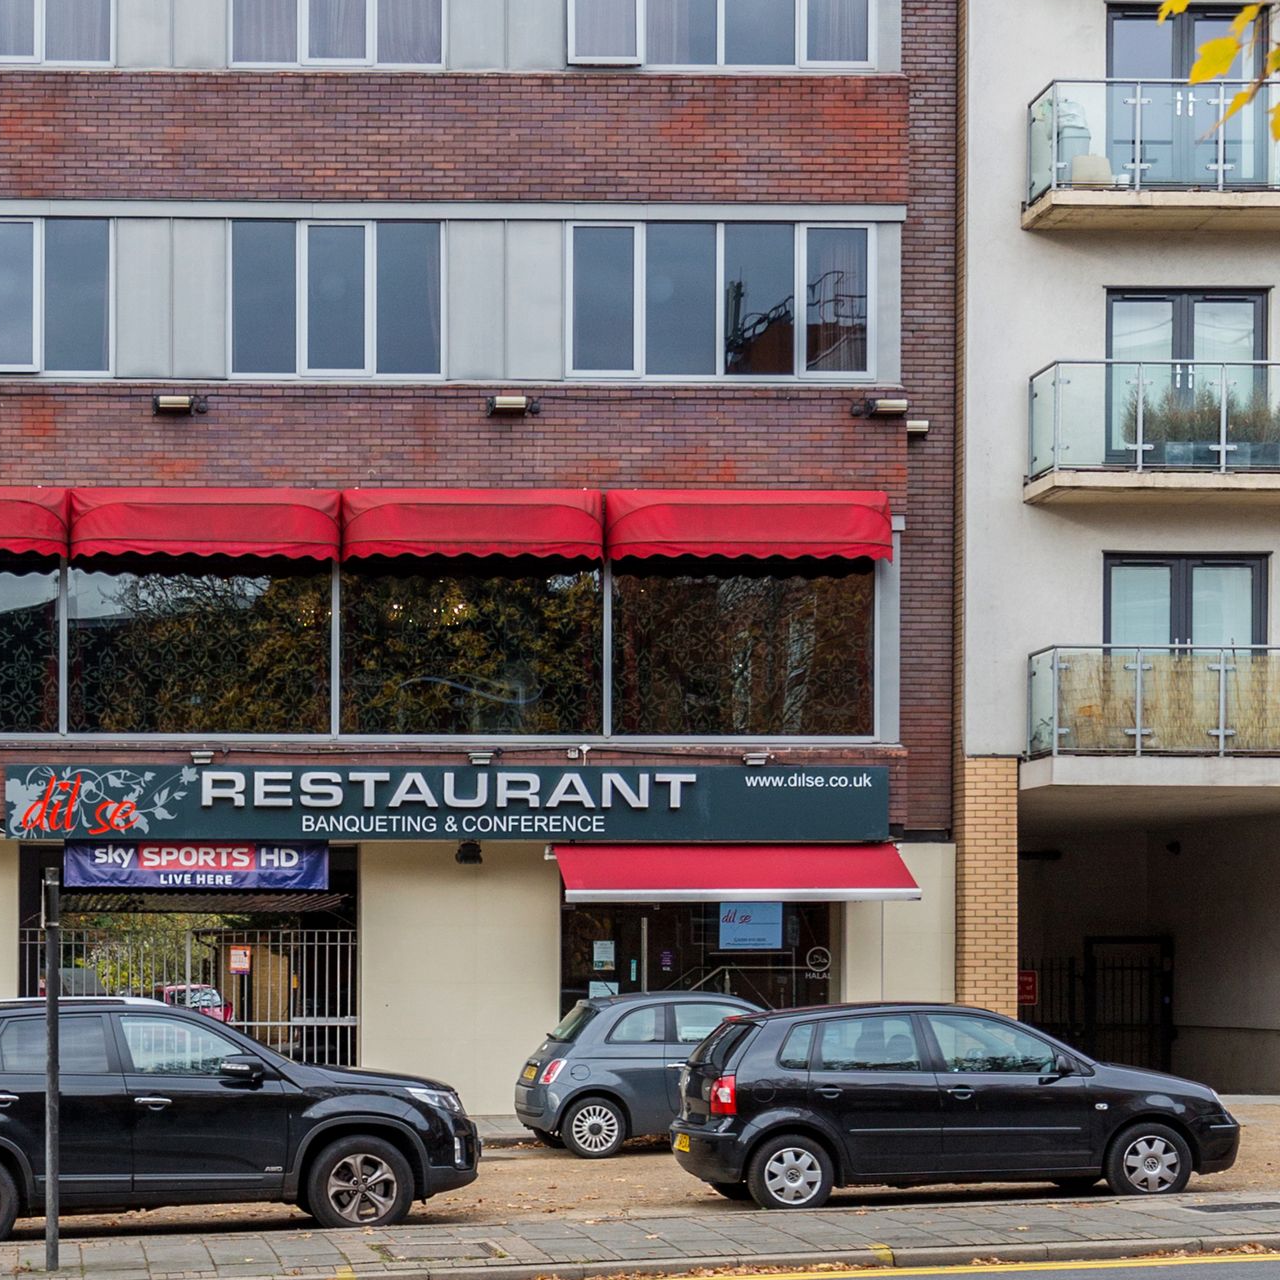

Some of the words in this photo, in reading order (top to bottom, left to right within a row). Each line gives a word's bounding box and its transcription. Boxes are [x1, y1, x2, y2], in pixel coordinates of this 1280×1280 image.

[200, 770, 697, 809] RESTAURANT
[301, 815, 437, 833] BANQUETING
[444, 815, 459, 833] &
[462, 815, 606, 833] CONFERENCE
[94, 845, 134, 869] sky
[142, 846, 251, 868] SPORTS
[260, 847, 300, 868] HD
[159, 873, 191, 885] LIVE
[196, 873, 233, 885] HERE
[805, 972, 832, 980] HALAL
